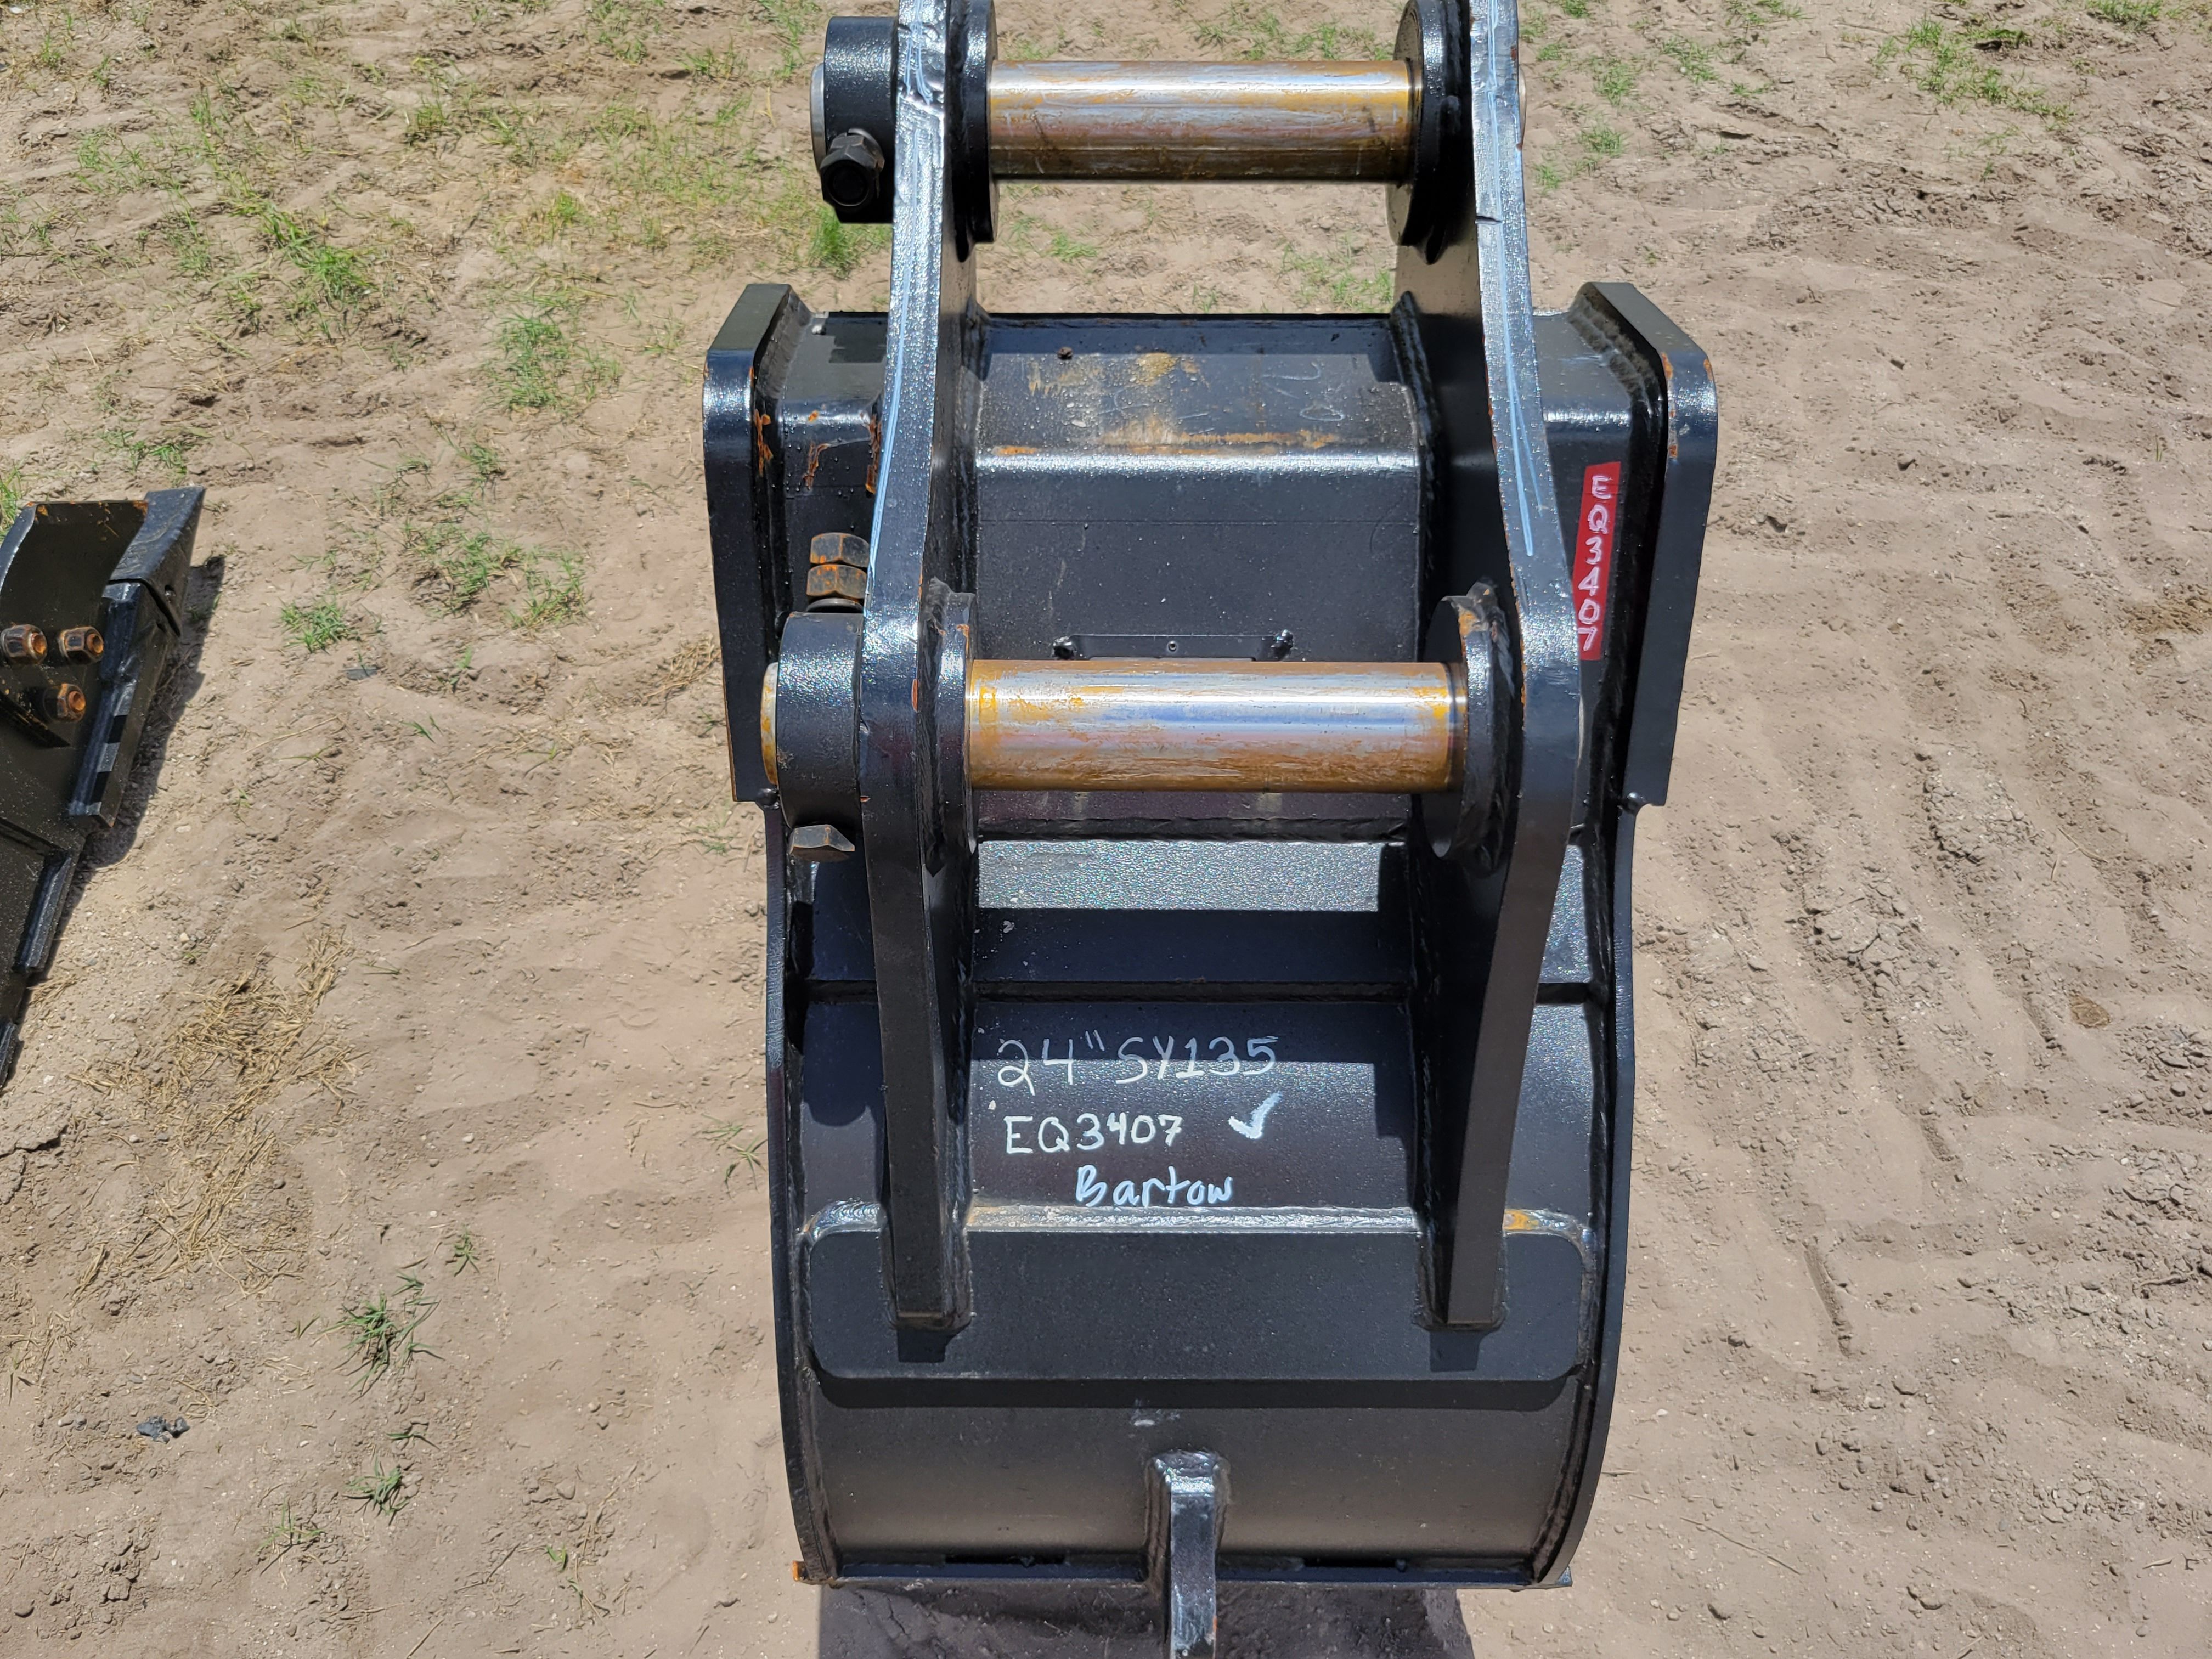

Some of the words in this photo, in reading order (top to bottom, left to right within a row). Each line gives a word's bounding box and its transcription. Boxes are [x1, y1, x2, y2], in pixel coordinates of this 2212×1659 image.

[1577, 475, 1612, 651] EQ3407
[998, 1030, 1105, 1096] 24"
[1115, 1035, 1278, 1084] SY135
[1003, 1113, 1183, 1153] EQ3407
[1075, 1165, 1233, 1207] Bartow
